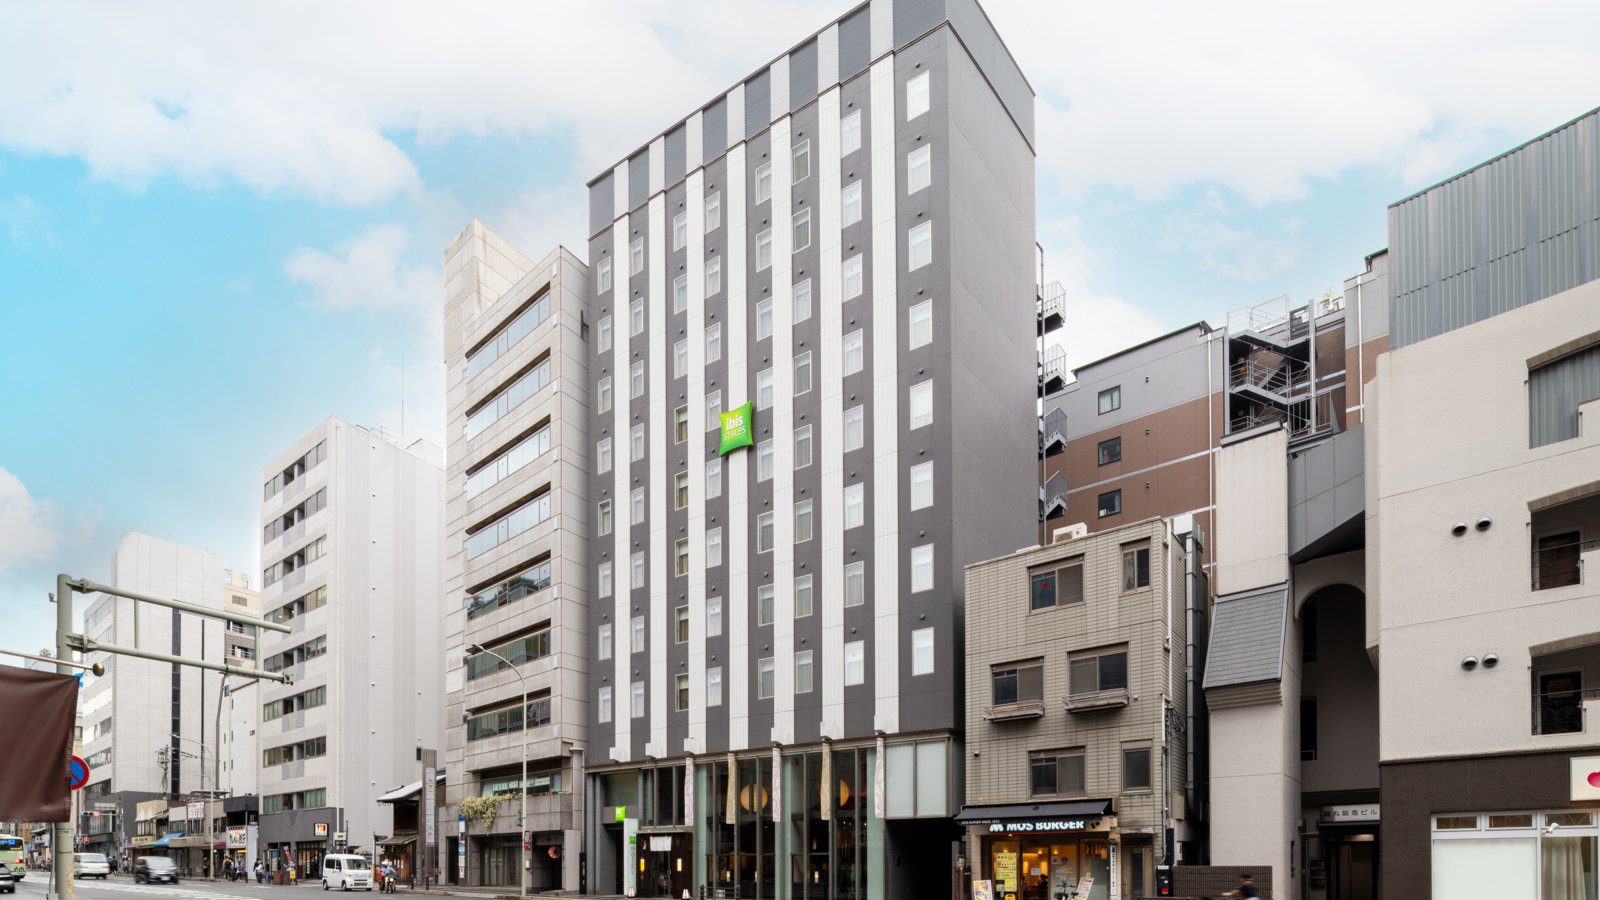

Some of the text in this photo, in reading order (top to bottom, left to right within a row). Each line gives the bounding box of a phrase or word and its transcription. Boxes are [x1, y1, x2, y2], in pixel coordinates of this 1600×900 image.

[726, 414, 744, 431] ibis
[1006, 820, 1085, 832] MOS BURGER
